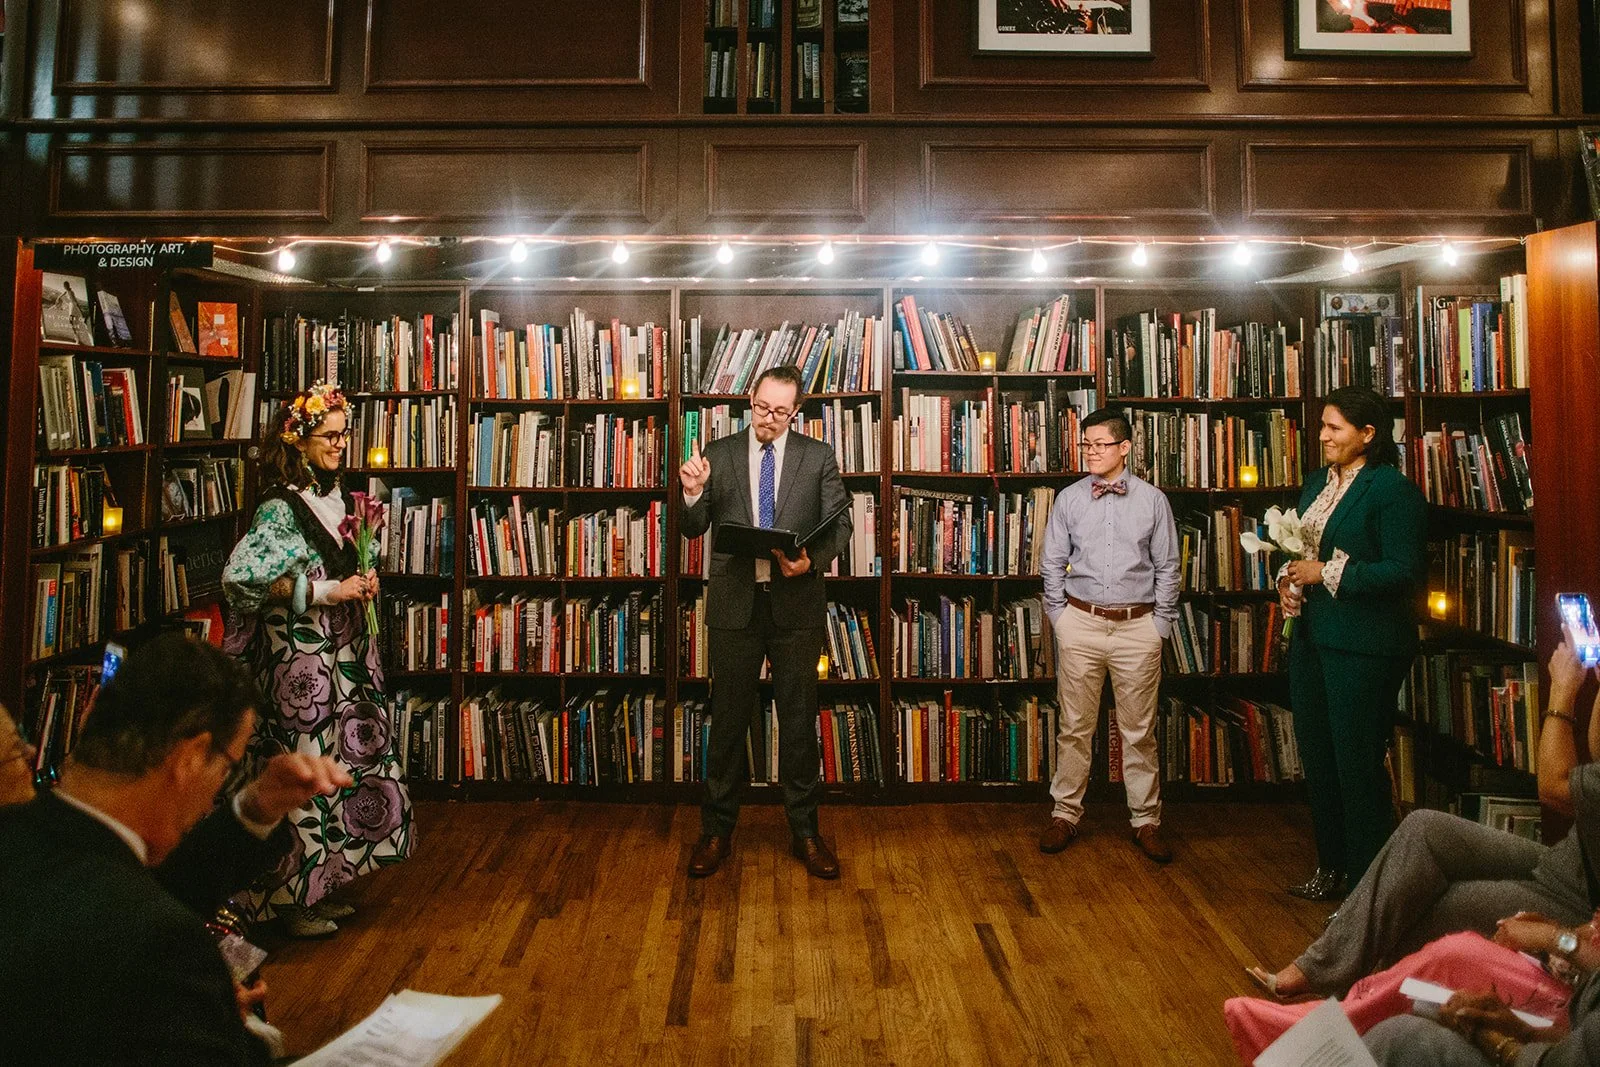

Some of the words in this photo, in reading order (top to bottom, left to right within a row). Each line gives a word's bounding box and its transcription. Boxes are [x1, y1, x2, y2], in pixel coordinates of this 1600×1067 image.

[64, 244, 156, 256] PHOTOGRAPHY,
[160, 243, 185, 255] ART,
[98, 258, 107, 268] &
[110, 257, 153, 267] DESIGN
[847, 711, 861, 782] RENAISSANCE
[534, 749, 544, 776] COVERS
